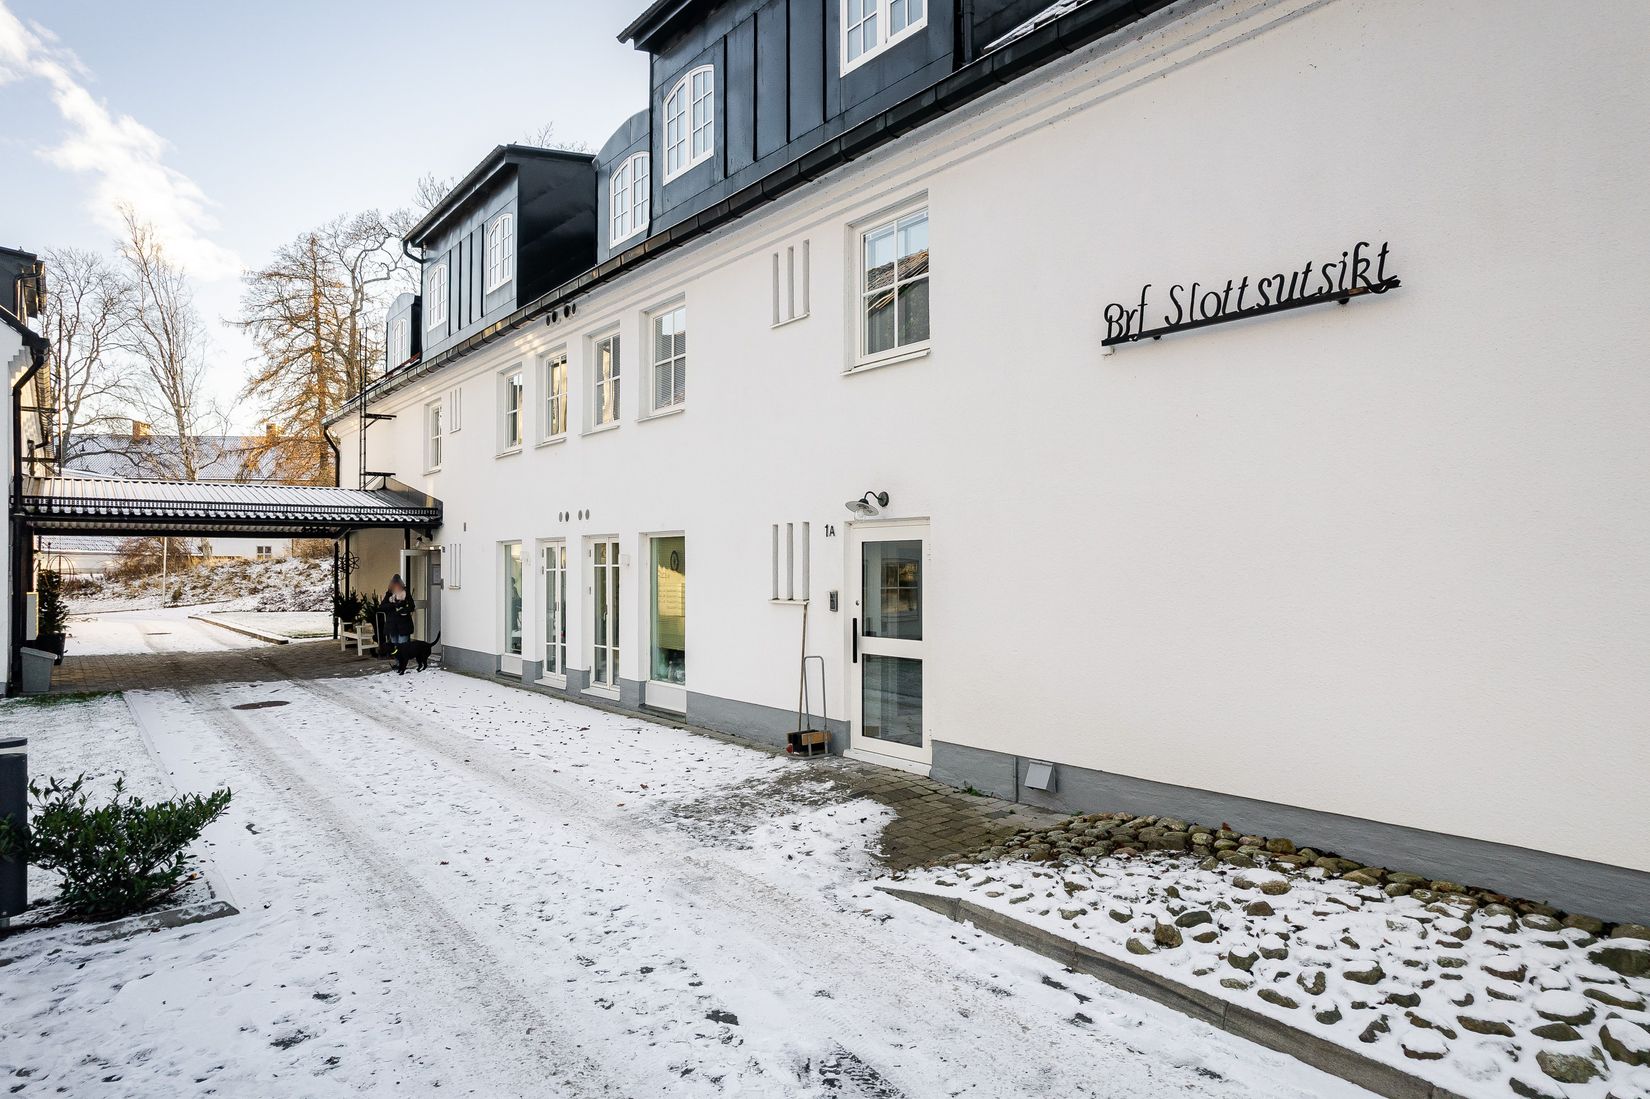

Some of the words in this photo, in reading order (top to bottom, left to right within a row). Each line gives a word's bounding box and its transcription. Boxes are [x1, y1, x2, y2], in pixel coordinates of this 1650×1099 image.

[1104, 284, 1152, 341] Brf
[1164, 241, 1398, 327] Slottsutsikt
[824, 524, 836, 538] 1A
